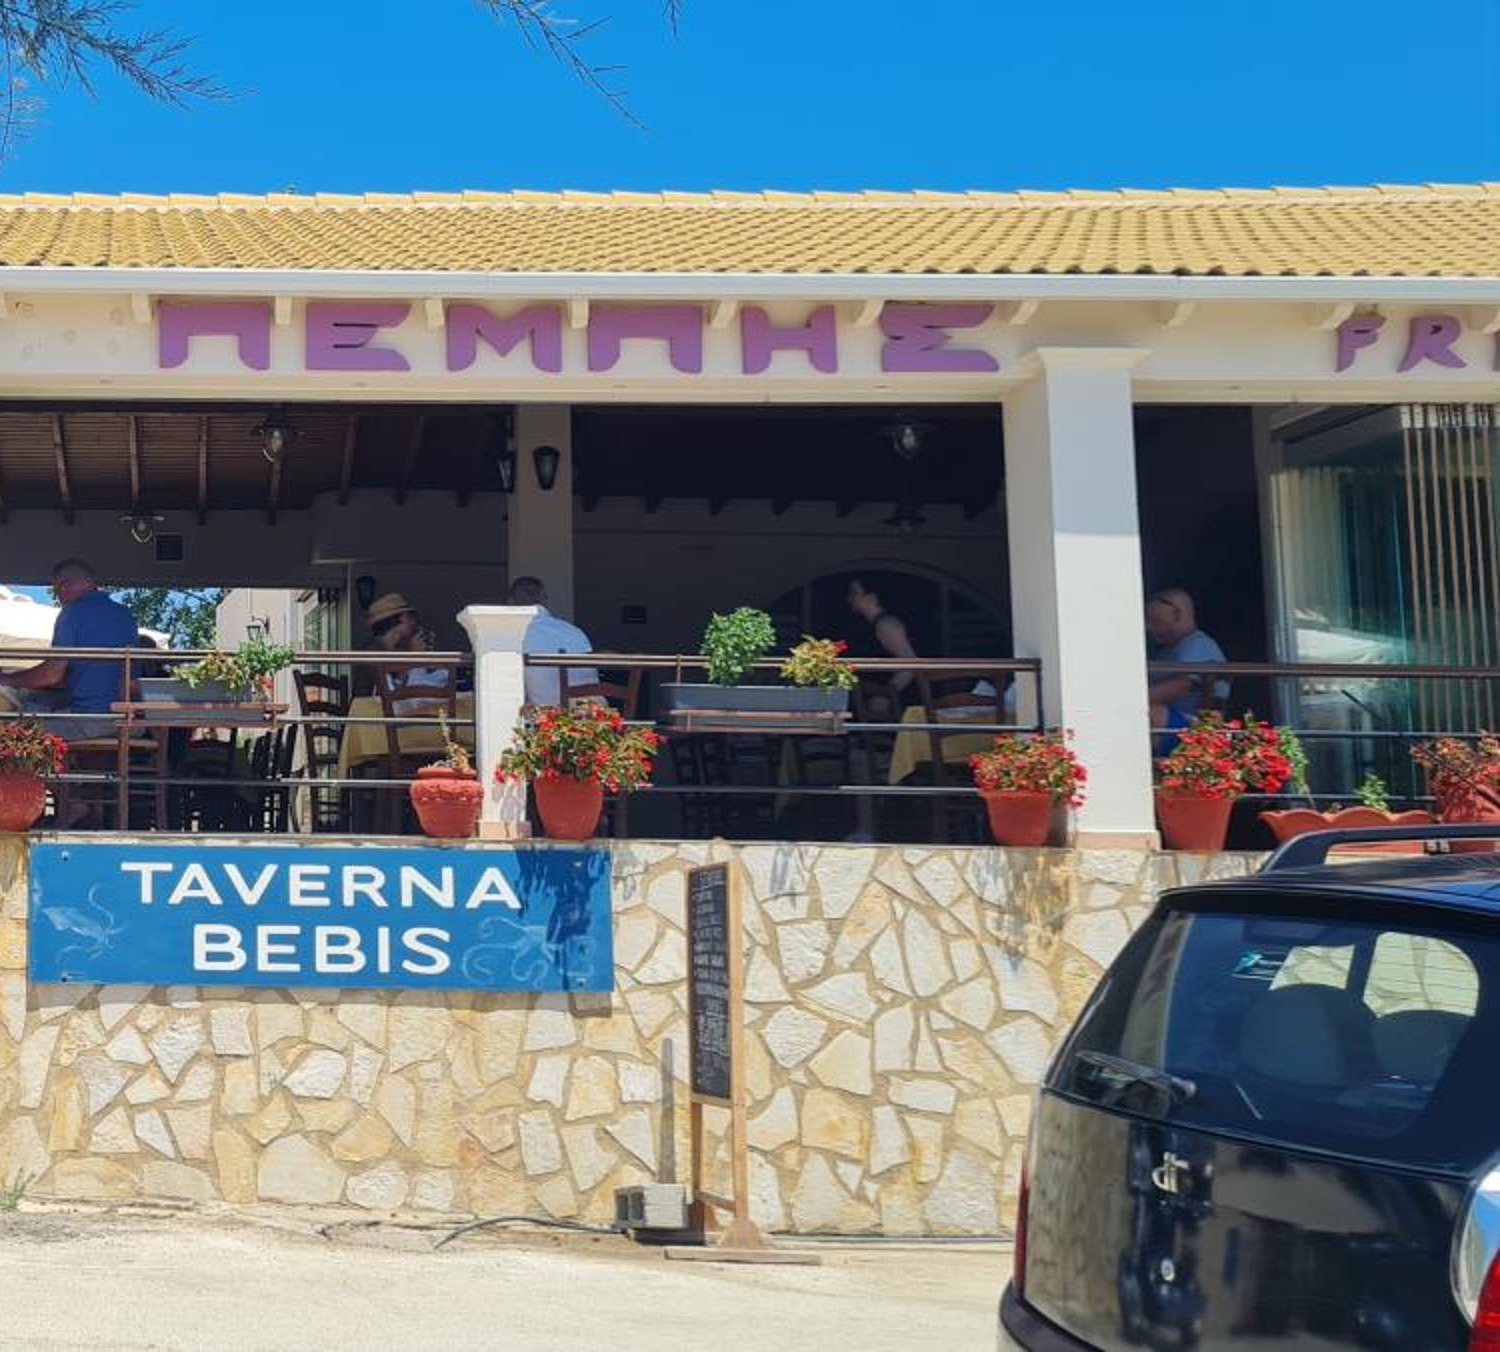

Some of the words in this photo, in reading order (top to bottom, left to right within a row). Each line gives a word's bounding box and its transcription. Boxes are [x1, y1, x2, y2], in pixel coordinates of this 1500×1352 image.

[158, 301, 1000, 375] ΠΕΜΠΗΣ
[1334, 314, 1500, 373] FR
[121, 862, 522, 910] TAVERNA
[193, 924, 452, 975] BEBIS
